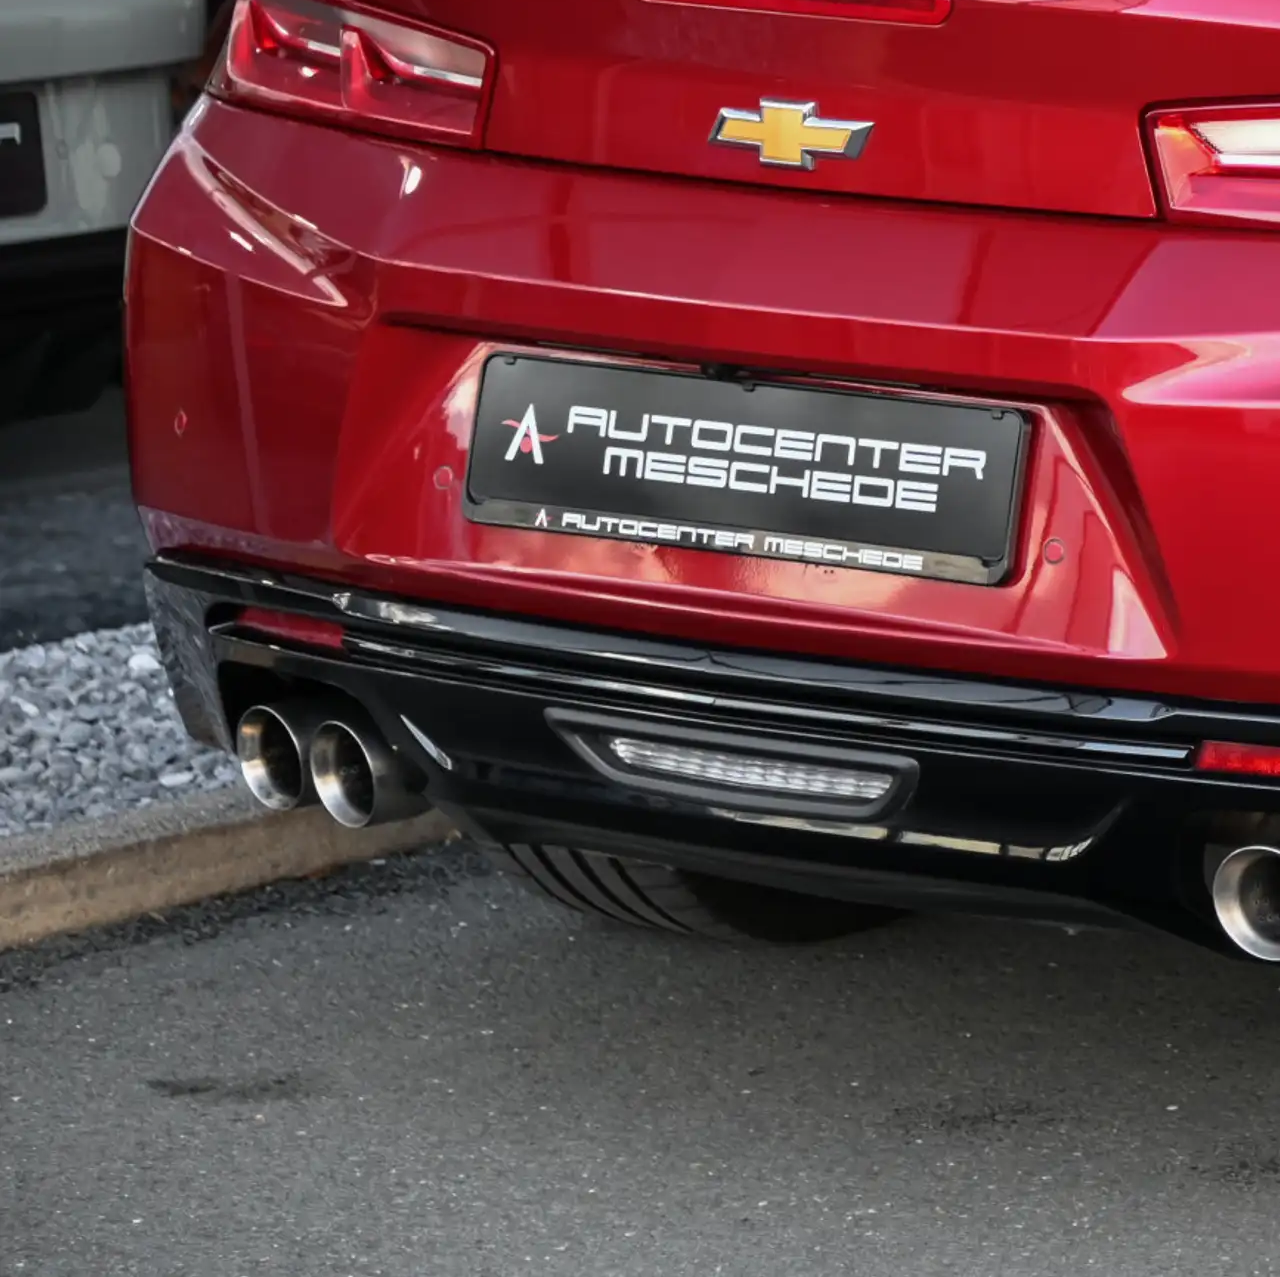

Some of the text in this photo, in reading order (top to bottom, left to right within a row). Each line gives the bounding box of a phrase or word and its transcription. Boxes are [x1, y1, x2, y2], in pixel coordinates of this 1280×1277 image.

[566, 405, 987, 481] AUTOCENTER
[602, 446, 939, 513] MESCHEDE
[561, 511, 755, 550] AUTOCENTER
[763, 536, 924, 571] MESCHEDE
